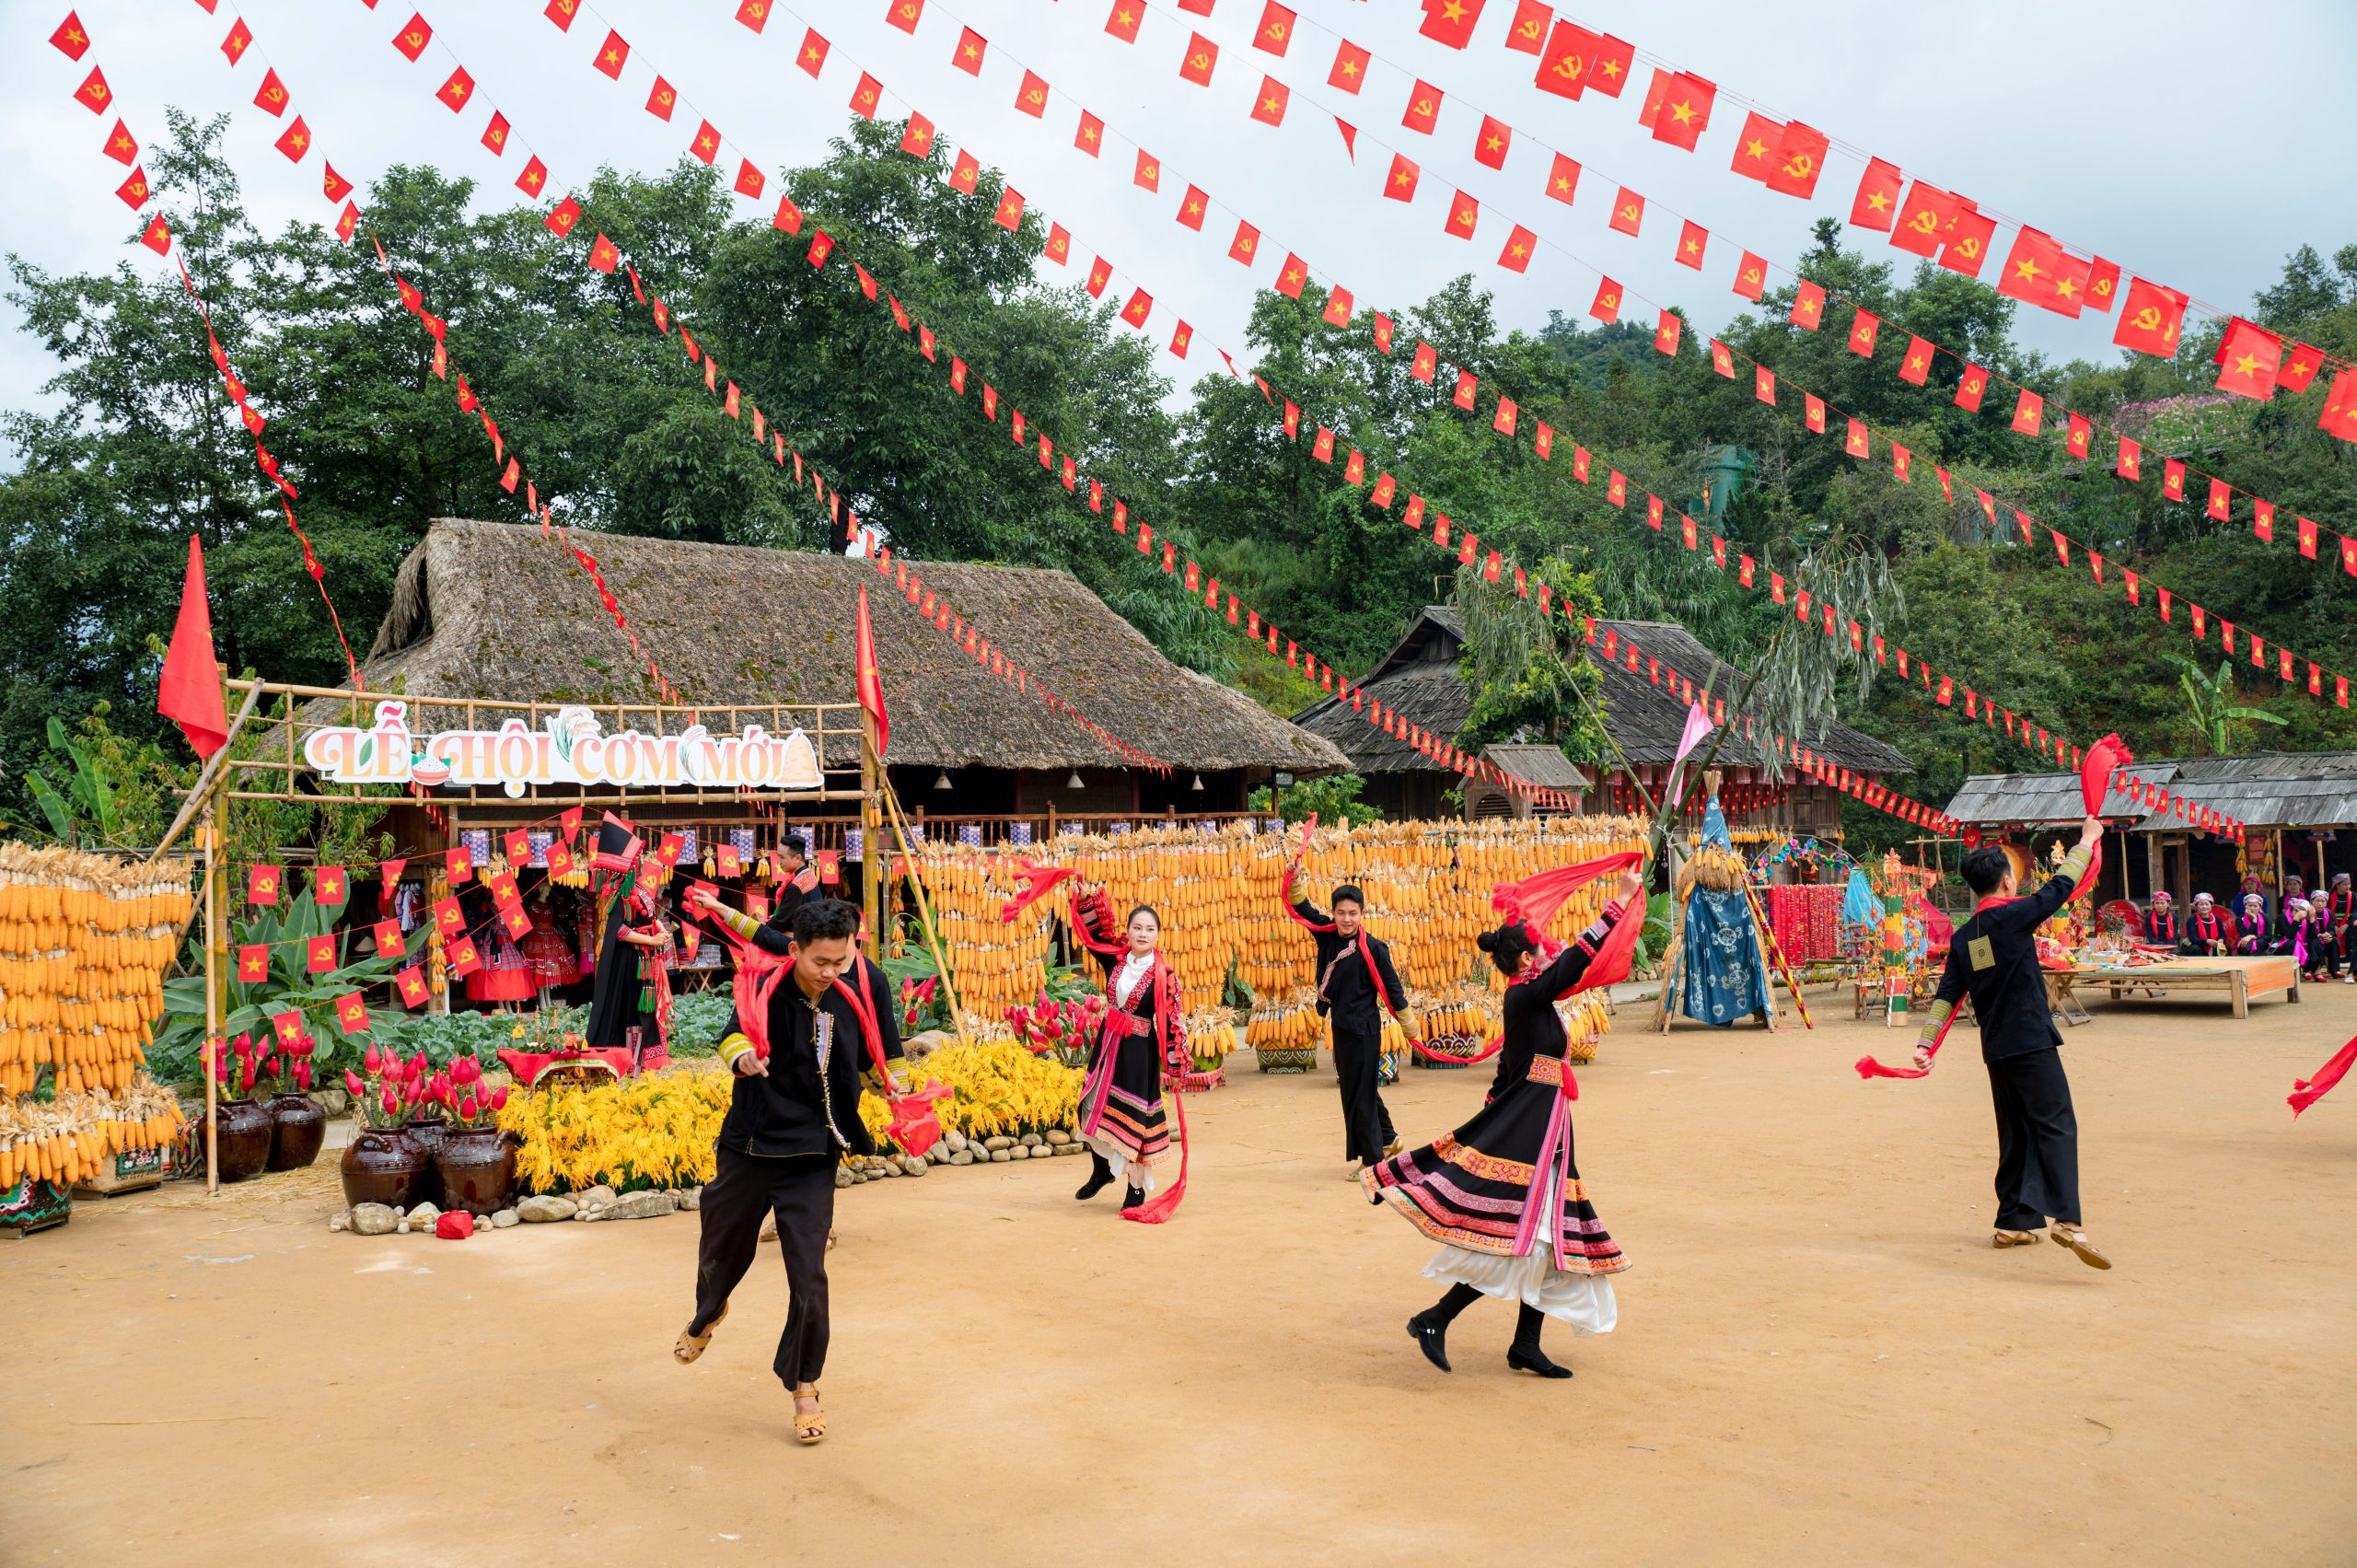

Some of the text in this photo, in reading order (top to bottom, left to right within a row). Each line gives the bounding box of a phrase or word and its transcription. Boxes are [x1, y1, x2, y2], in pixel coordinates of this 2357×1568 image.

[312, 705, 784, 793] LỄ HỘI CƠM MỚI
